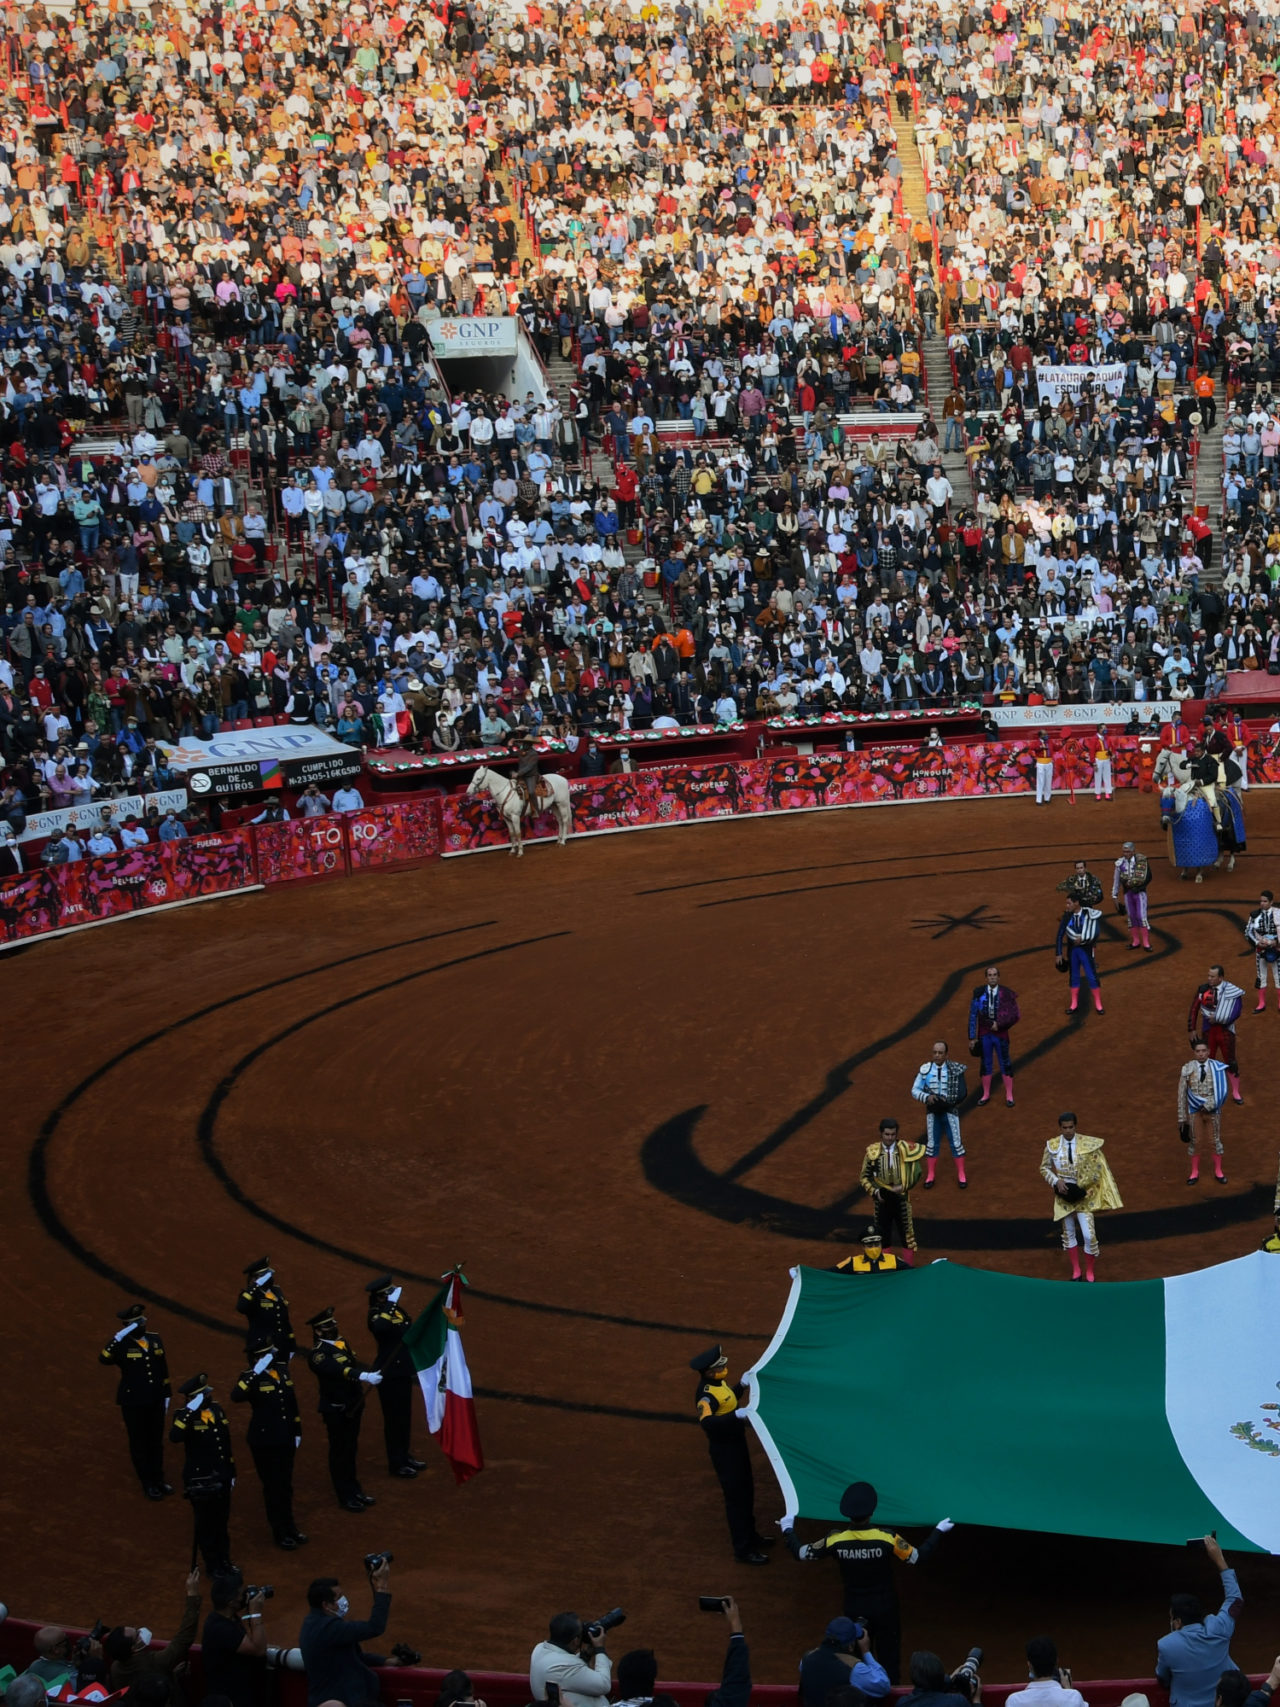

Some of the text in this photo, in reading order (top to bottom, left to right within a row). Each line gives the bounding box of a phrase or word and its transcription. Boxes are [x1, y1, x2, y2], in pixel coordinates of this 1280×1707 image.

[459, 323, 499, 338] GNP
[1038, 371, 1123, 383] #LATAUROAQUIA
[994, 710, 1017, 721] GNP
[1034, 709, 1057, 719] GNP
[1073, 708, 1097, 718] GNP
[1113, 707, 1137, 717] GNP
[1153, 706, 1176, 716] GNP
[208, 735, 313, 757] GNP
[208, 764, 258, 777] BERNALDO
[302, 758, 344, 774] CUMPLIDO
[119, 798, 142, 813] GNP
[158, 794, 183, 806] GNP
[39, 815, 62, 831] GNP
[196, 838, 224, 849] FUERZA
[64, 904, 84, 915] ARTE
[837, 1547, 882, 1560] TRANSITO
